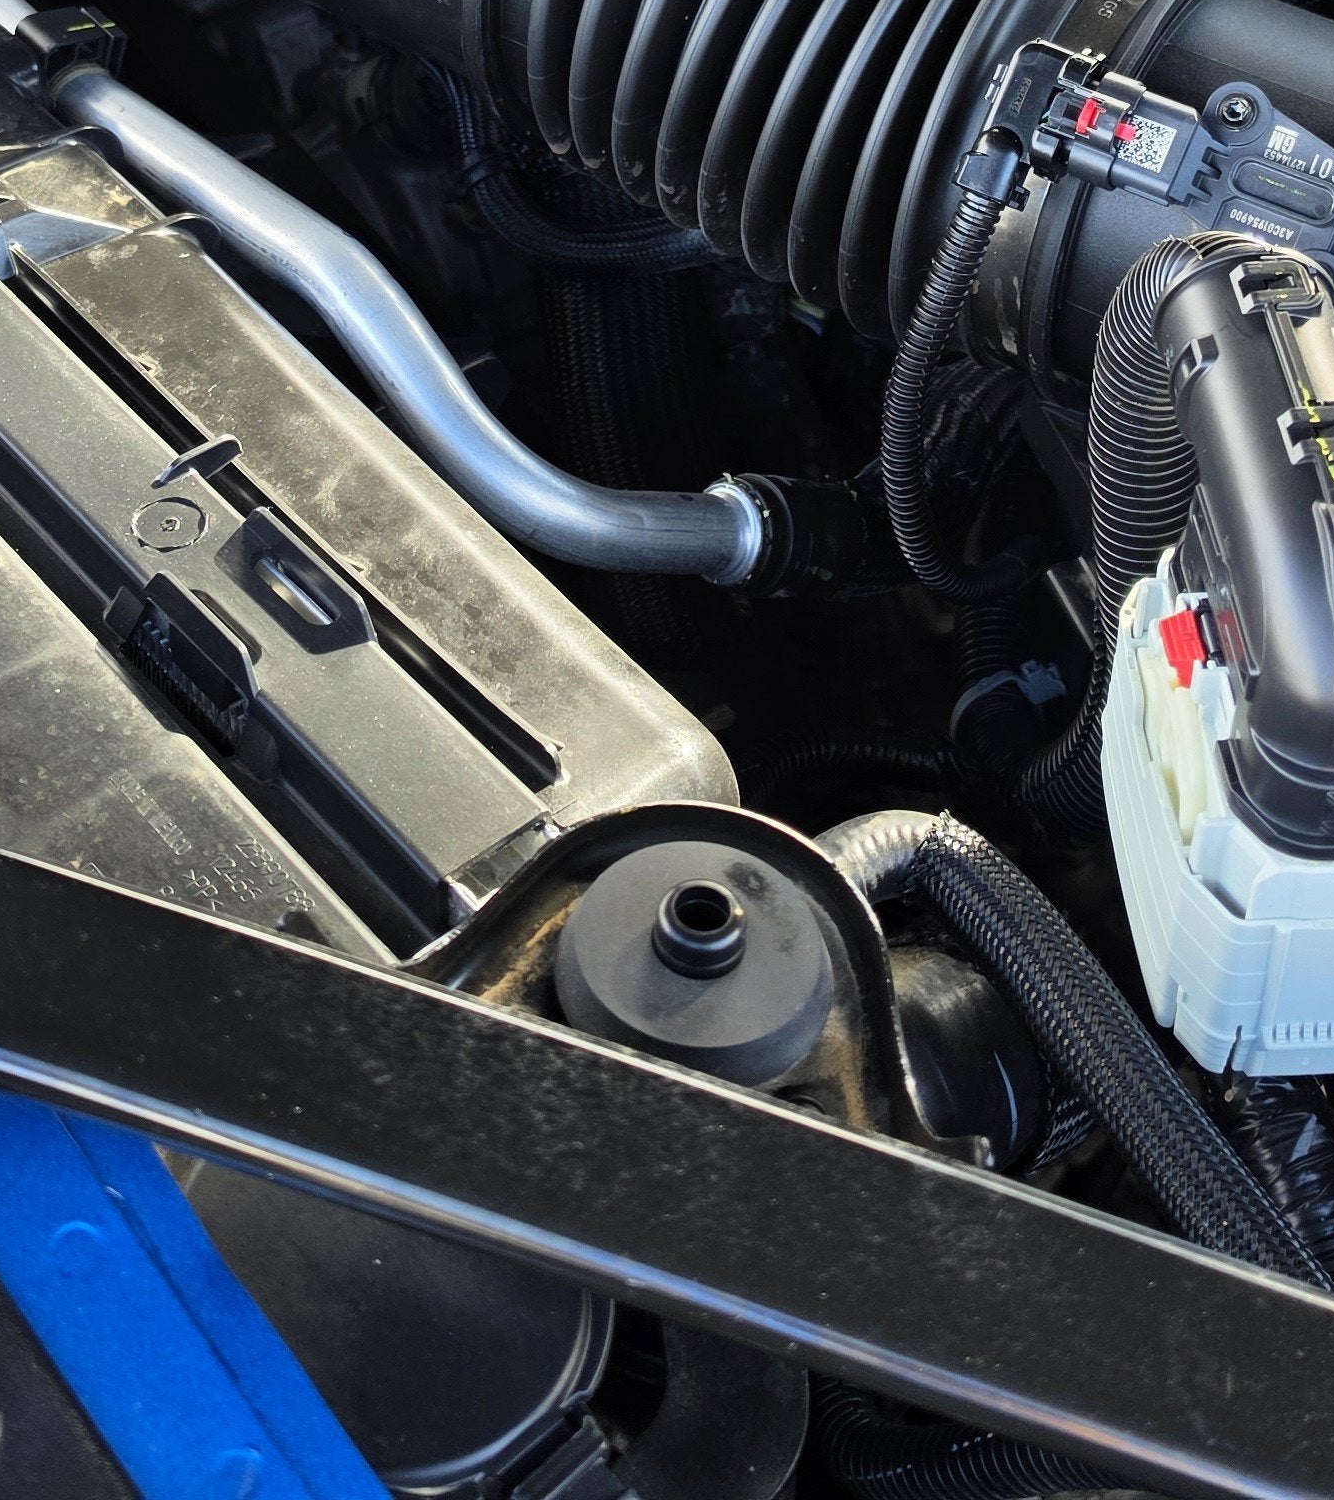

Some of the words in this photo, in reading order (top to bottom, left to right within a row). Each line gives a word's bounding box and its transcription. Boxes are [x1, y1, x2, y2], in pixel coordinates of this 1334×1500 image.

[1266, 128, 1297, 155] GM
[1263, 147, 1306, 171] 12714453
[1228, 207, 1294, 241] A3C01954900
